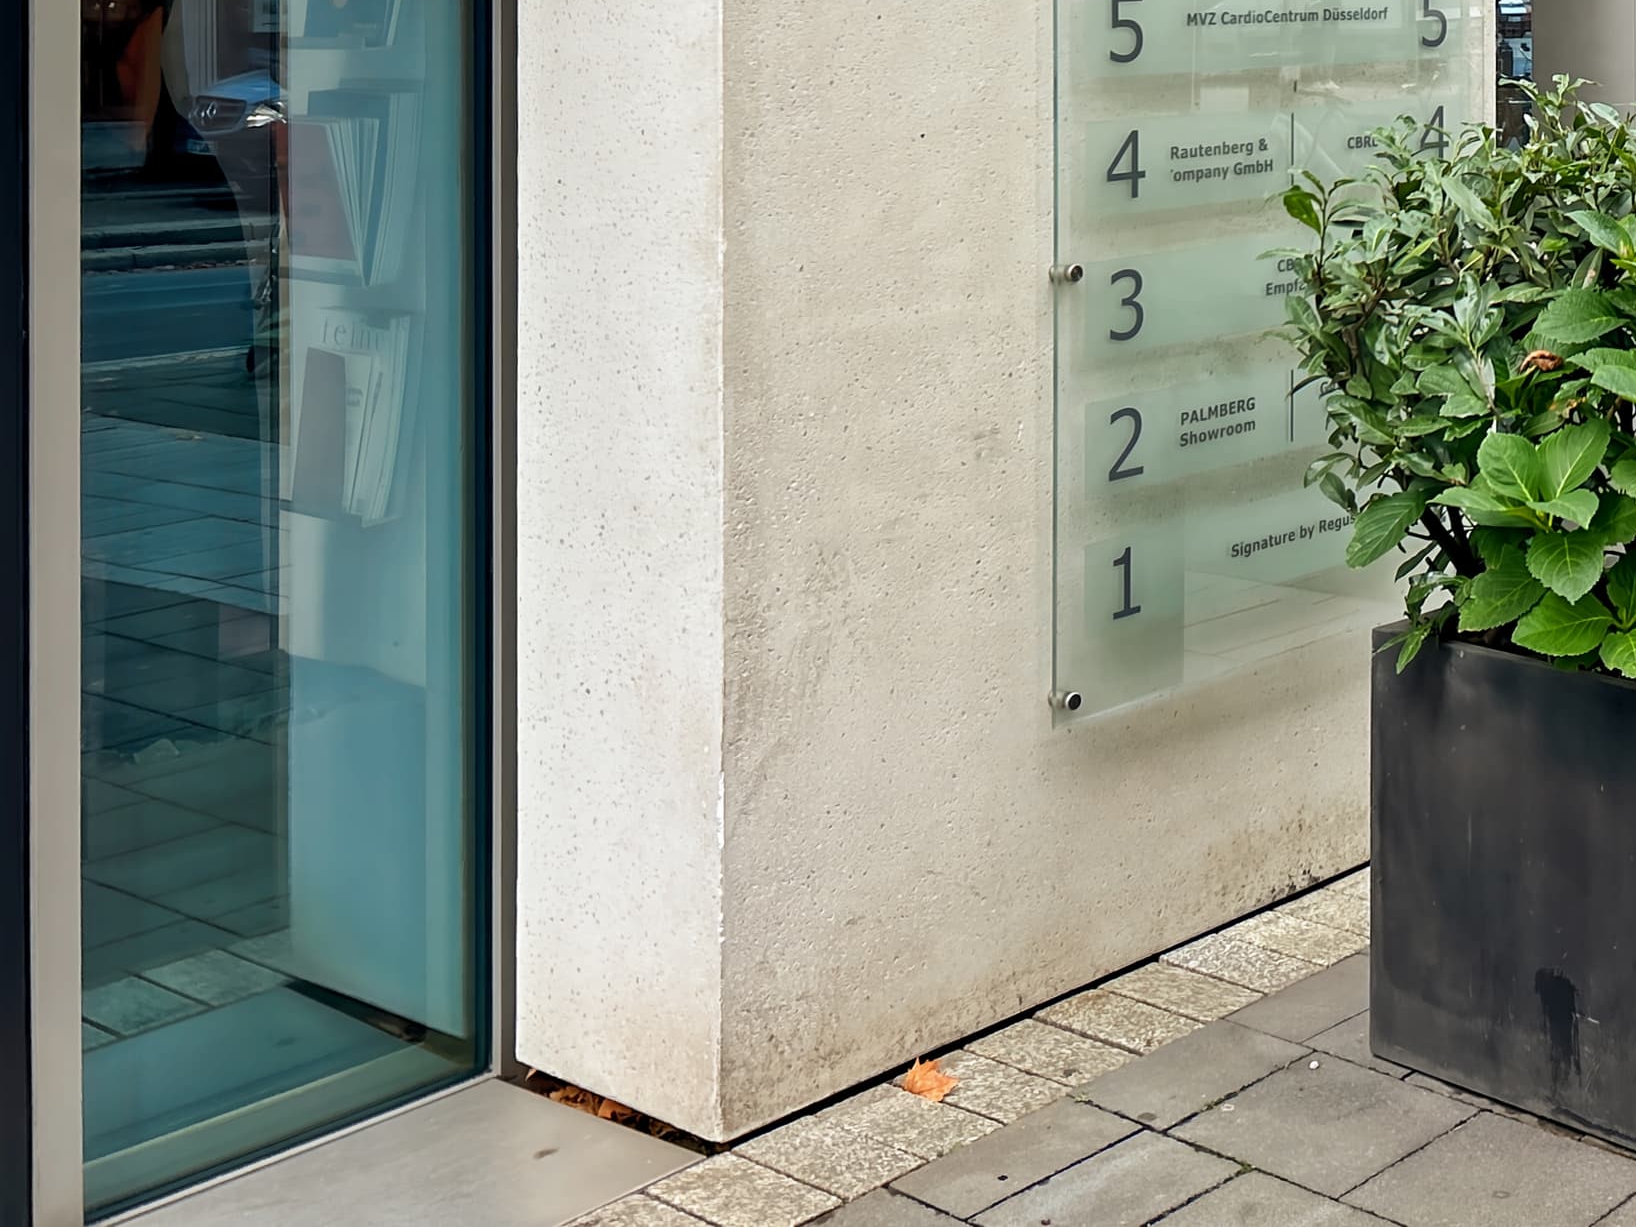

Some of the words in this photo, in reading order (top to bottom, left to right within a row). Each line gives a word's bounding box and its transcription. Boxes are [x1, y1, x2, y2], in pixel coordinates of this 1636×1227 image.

[1187, 12, 1216, 26] MVZ
[1221, 9, 1319, 25] CardioCentrum
[1323, 7, 1388, 23] Düsseldorf
[1421, 106, 1449, 158] 4
[1106, 130, 1146, 199] 4
[1170, 141, 1253, 160] Rautenberg
[1258, 138, 1268, 151] &
[1170, 166, 1229, 183] ompany
[1233, 159, 1273, 175] GmbH
[1109, 270, 1144, 341] 3
[1181, 397, 1256, 426] PALMBERG
[1108, 407, 1144, 482] 2
[1179, 418, 1256, 447] Showroom
[1231, 531, 1295, 557] Signature
[1300, 525, 1314, 539] by
[1112, 546, 1141, 620] 1
